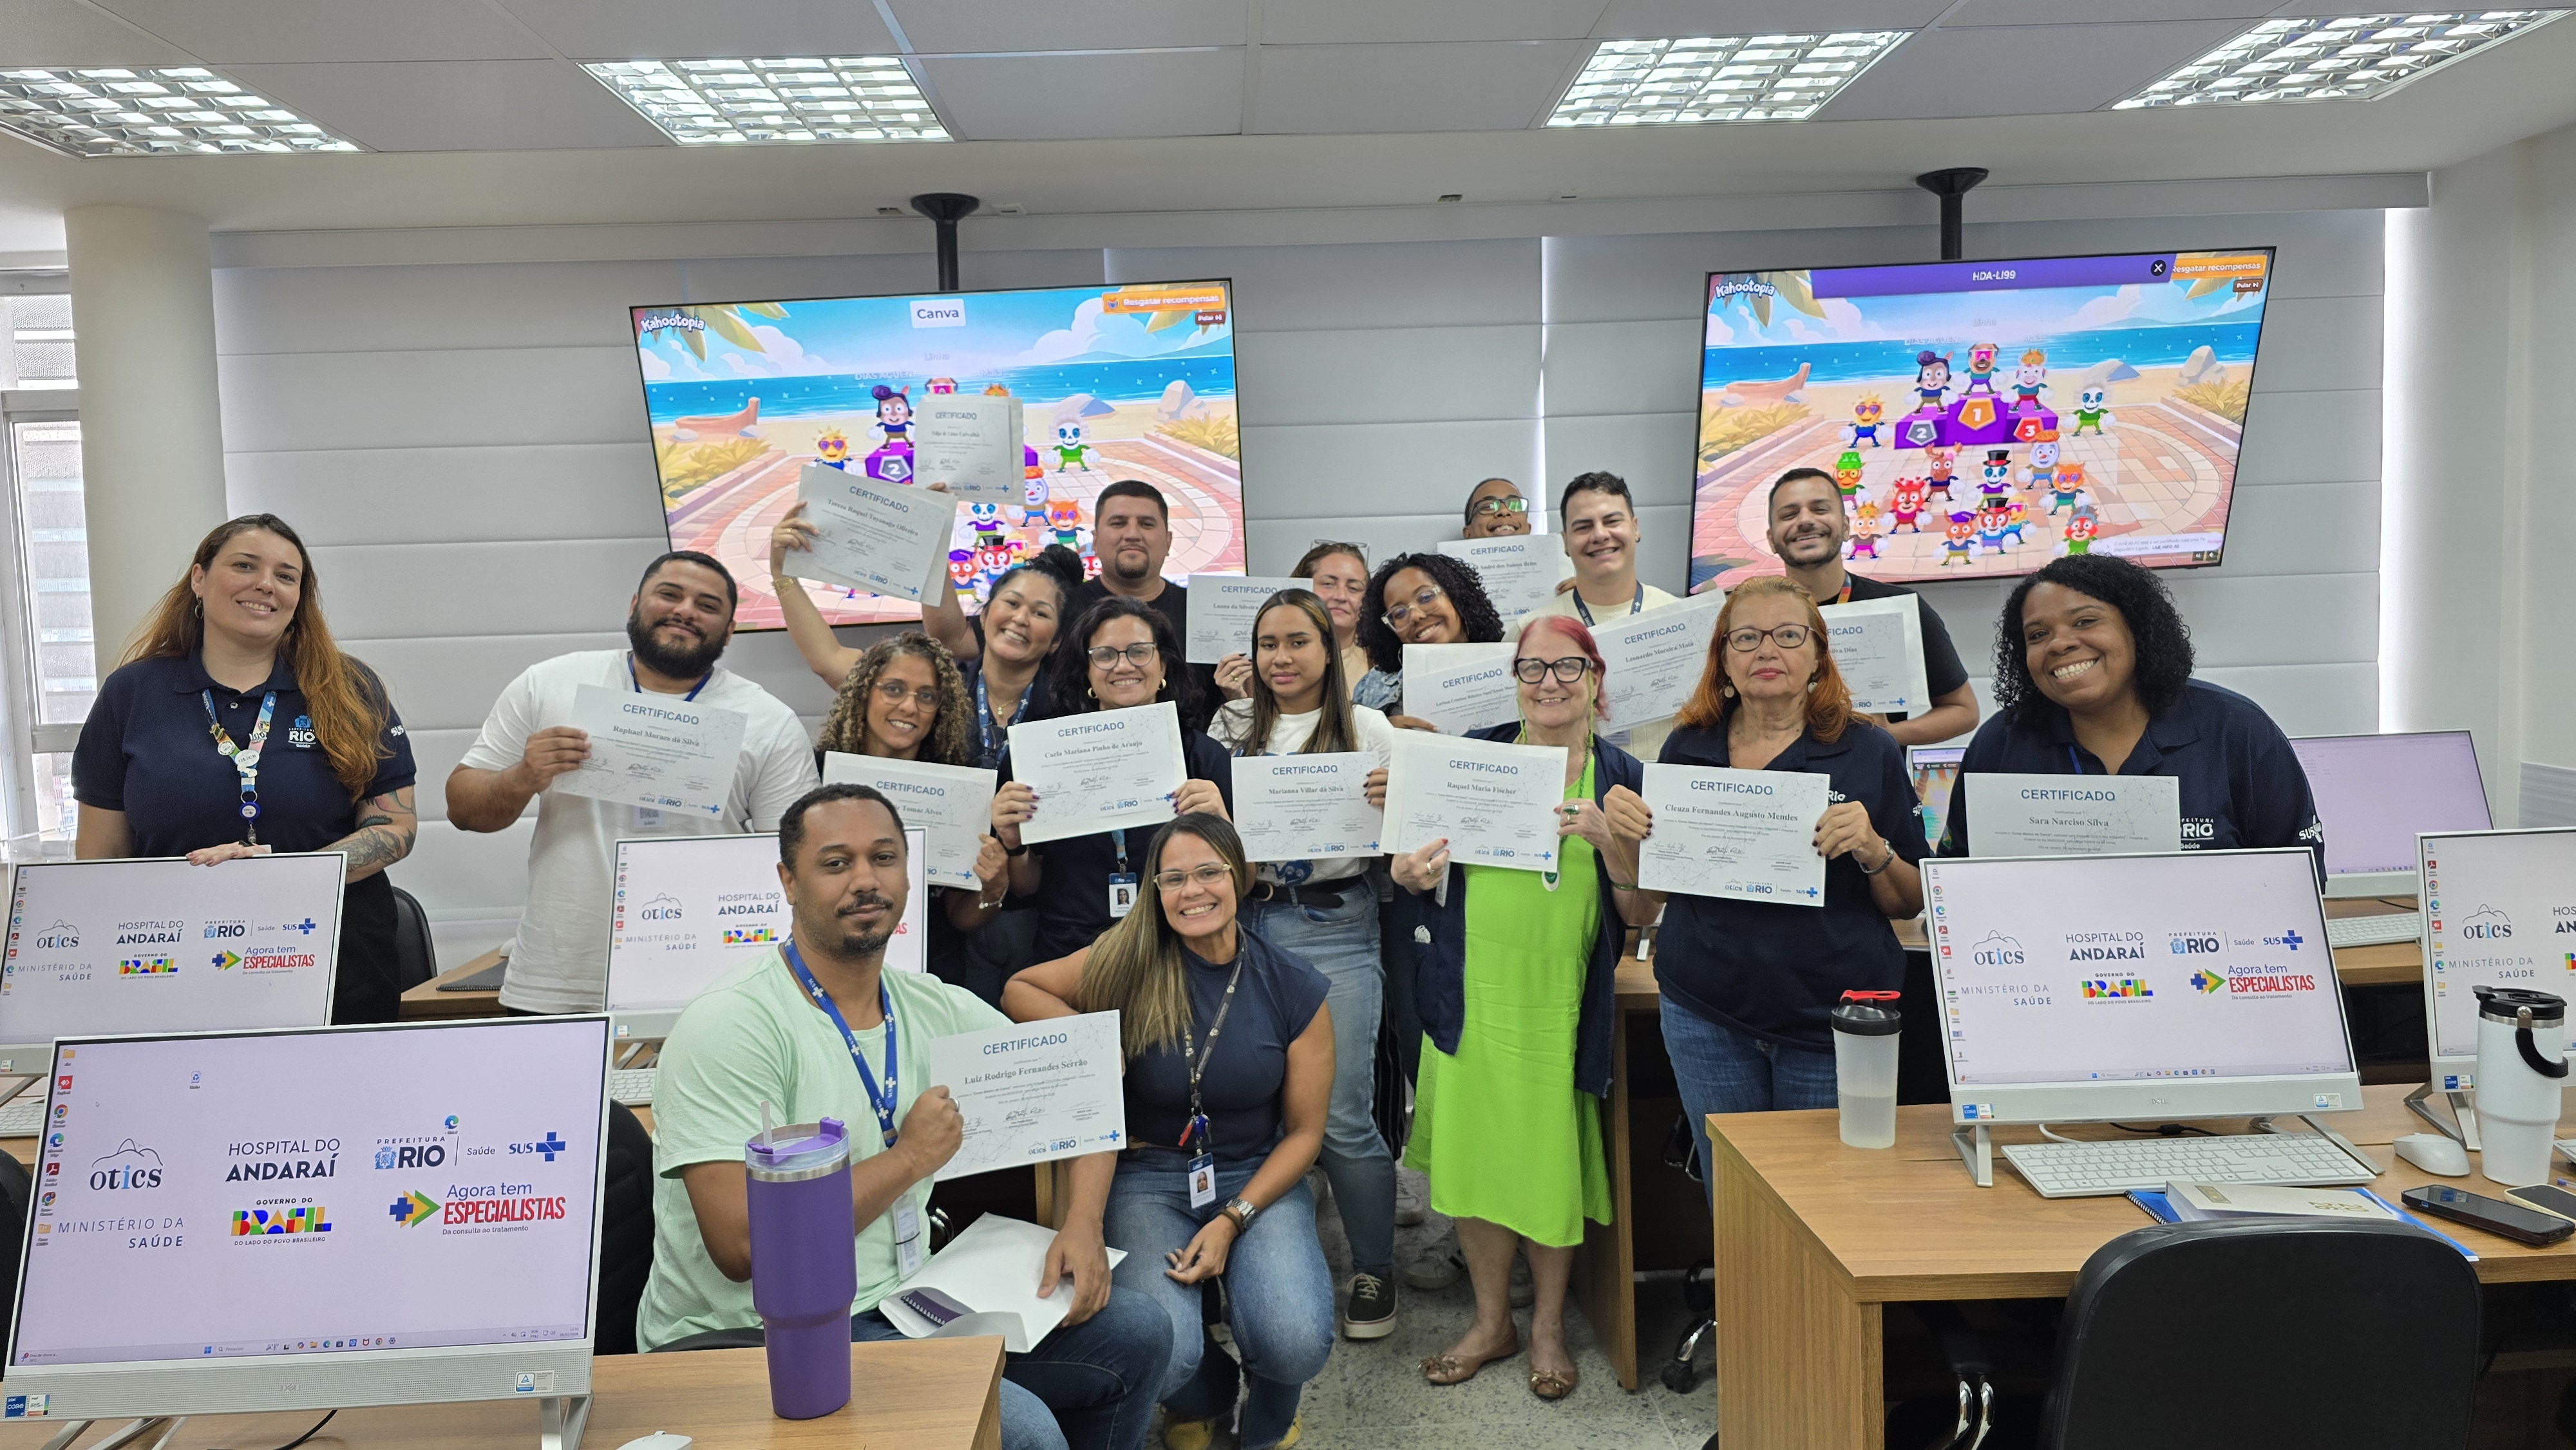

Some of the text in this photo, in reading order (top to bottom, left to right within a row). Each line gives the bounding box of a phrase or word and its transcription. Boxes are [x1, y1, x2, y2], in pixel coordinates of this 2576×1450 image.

[2208, 263, 2260, 273] recompensas
[1973, 270, 2016, 281] HDA-LI99
[1716, 280, 1775, 298] Kahootopia
[917, 308, 960, 321] Canva
[641, 315, 705, 333] Kahootopia
[935, 411, 977, 420] CERTIFICADO
[1973, 408, 1982, 421] 1
[1917, 428, 1927, 438] 2
[2025, 425, 2036, 437] 3
[888, 465, 901, 475] 2
[849, 486, 909, 513] CERTIFICADO
[1470, 545, 1524, 555] CERTIFICADO
[1221, 585, 1278, 594] CERTIFICADO
[1624, 623, 1686, 645] CERTIFICADO
[1625, 641, 1694, 663] Leonardo Moreira Maia
[1443, 668, 1502, 688] CERTIFICADO
[623, 704, 699, 725] CERTIFICADO
[289, 731, 316, 742] RIO
[613, 725, 643, 737] Raphael
[682, 738, 700, 747] Silva
[1057, 722, 1124, 737] CERTIFICADO
[1064, 747, 1091, 757] Mariana
[1273, 765, 1338, 775] CERTIFICADO
[1449, 760, 1518, 775] CERTIFICADO
[876, 780, 945, 796] CERTIFICADO
[1447, 781, 1517, 795] Raquel Maria Fischer
[1690, 780, 1773, 795] CERTIFICADO
[2021, 789, 2116, 802] CERTIFICADO
[1124, 800, 1138, 808] RIO
[1665, 804, 1798, 822] Cleuza Fernandes Augusto Mendes
[2029, 816, 2108, 827] Sara Narciso Silva
[2183, 824, 2213, 837] RIO
[1755, 885, 1772, 894] RIO
[718, 893, 764, 901] HOSPITAL
[641, 906, 683, 920] otics
[717, 903, 779, 916] ANDARAÍ
[118, 921, 166, 930] HOSPITAL
[217, 925, 245, 937] RIO
[2463, 921, 2512, 939] otics
[37, 932, 79, 948] otics
[117, 928, 183, 944] ANDARAÍ
[625, 934, 682, 943] MINISTÉRIO
[723, 928, 779, 943] BRASIL
[2066, 932, 2143, 943] HOSPITAL DO
[245, 946, 274, 956] Agora
[666, 942, 697, 950] SAÚDE
[2070, 942, 2145, 960] ANDARAÍ
[2186, 938, 2219, 954] RIO
[2263, 937, 2280, 945] SUS
[243, 954, 315, 969] ESPECIALISTAS
[1975, 948, 2025, 965] otics
[2448, 957, 2533, 968] MINISTÉRIO DA
[17, 963, 75, 972] MINISTÉRIO
[119, 959, 178, 974] BRASIL
[2228, 964, 2287, 976] Agora tem
[2498, 968, 2535, 979] SAÚDE
[59, 972, 92, 981] SAÚDE
[2229, 975, 2315, 992] ESPECIALISTAS
[1961, 984, 2049, 994] MINISTÉRIO DA
[2081, 979, 2153, 998] BRASIL
[2014, 995, 2052, 1006] SAÚDE
[983, 1033, 1067, 1055] CERTIFICADO
[965, 1059, 1088, 1085] Luiz Rodrigo Fernandes Serrão
[229, 1138, 341, 1156] HOSPITAL DO
[377, 1136, 446, 1144] PREFEITURA
[1059, 1139, 1077, 1151] RIO
[397, 1143, 533, 1169] RIO Saúde SUS
[225, 1153, 339, 1182] ANDARAÍ
[90, 1165, 162, 1191] otics
[446, 1183, 533, 1201] Agora tem
[444, 1196, 566, 1225] ESPECIALISTAS
[58, 1217, 184, 1233] MINISTÉRIO DA
[231, 1207, 332, 1236] BRASIL
[129, 1234, 183, 1248] SAÚDE
